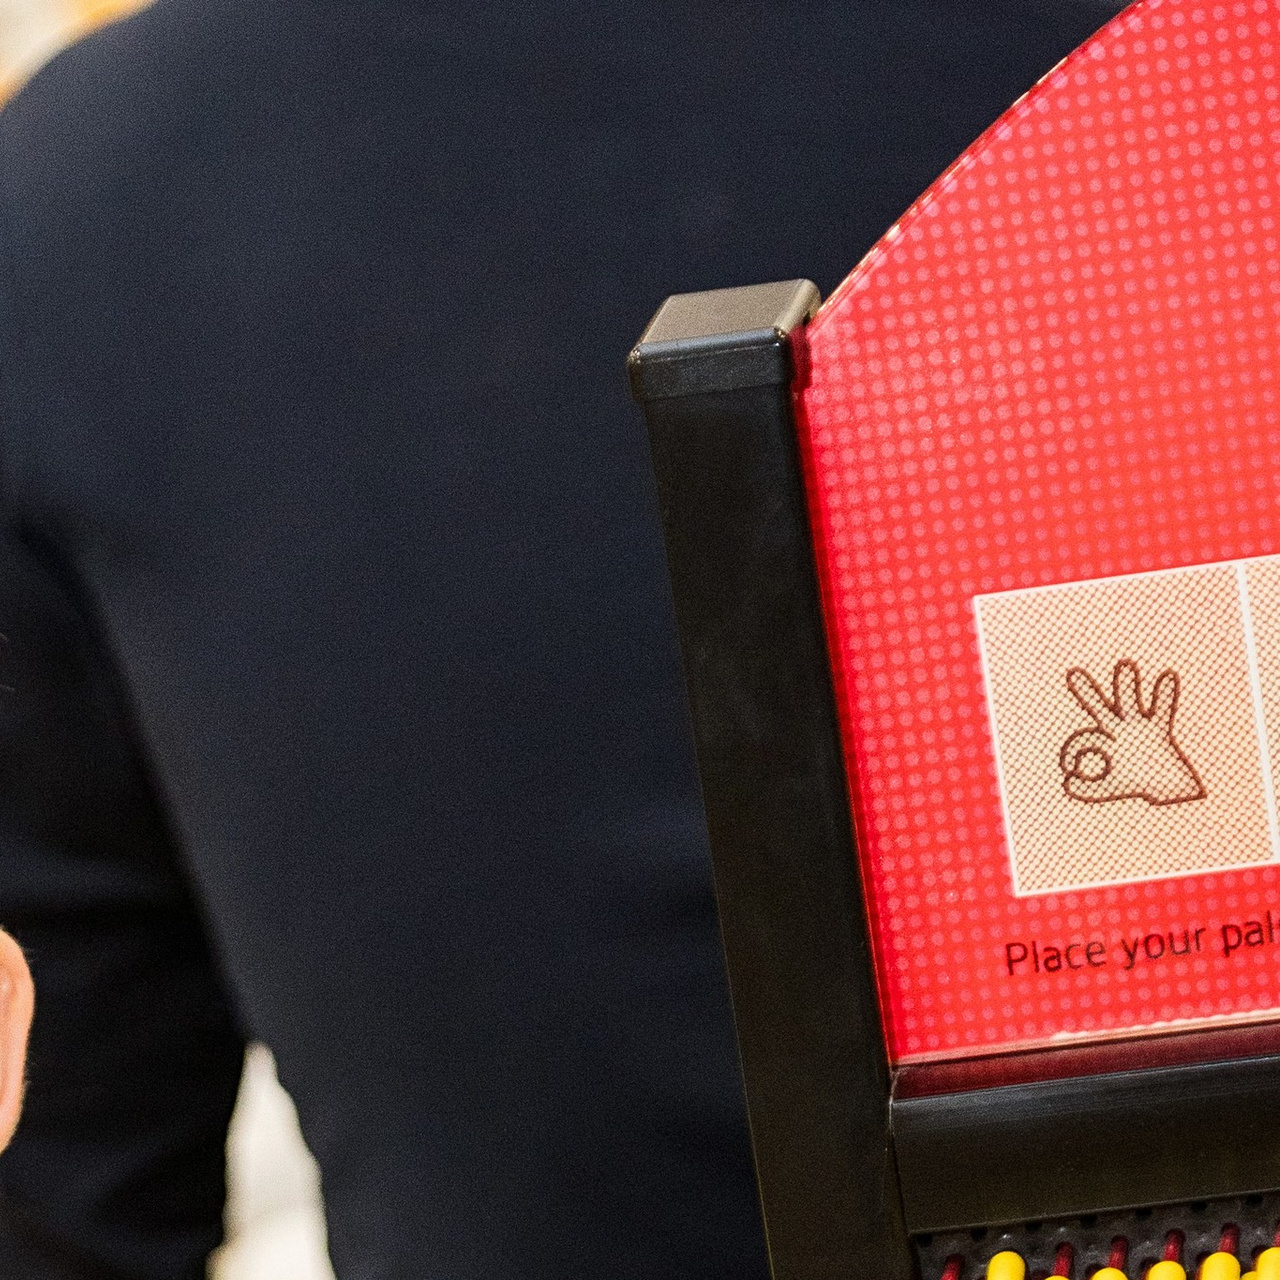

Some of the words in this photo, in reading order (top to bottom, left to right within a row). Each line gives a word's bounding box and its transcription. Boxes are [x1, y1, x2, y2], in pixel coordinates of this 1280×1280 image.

[1005, 940, 1107, 976] Place
[1121, 926, 1207, 970] your
[1220, 910, 1280, 957] pal
